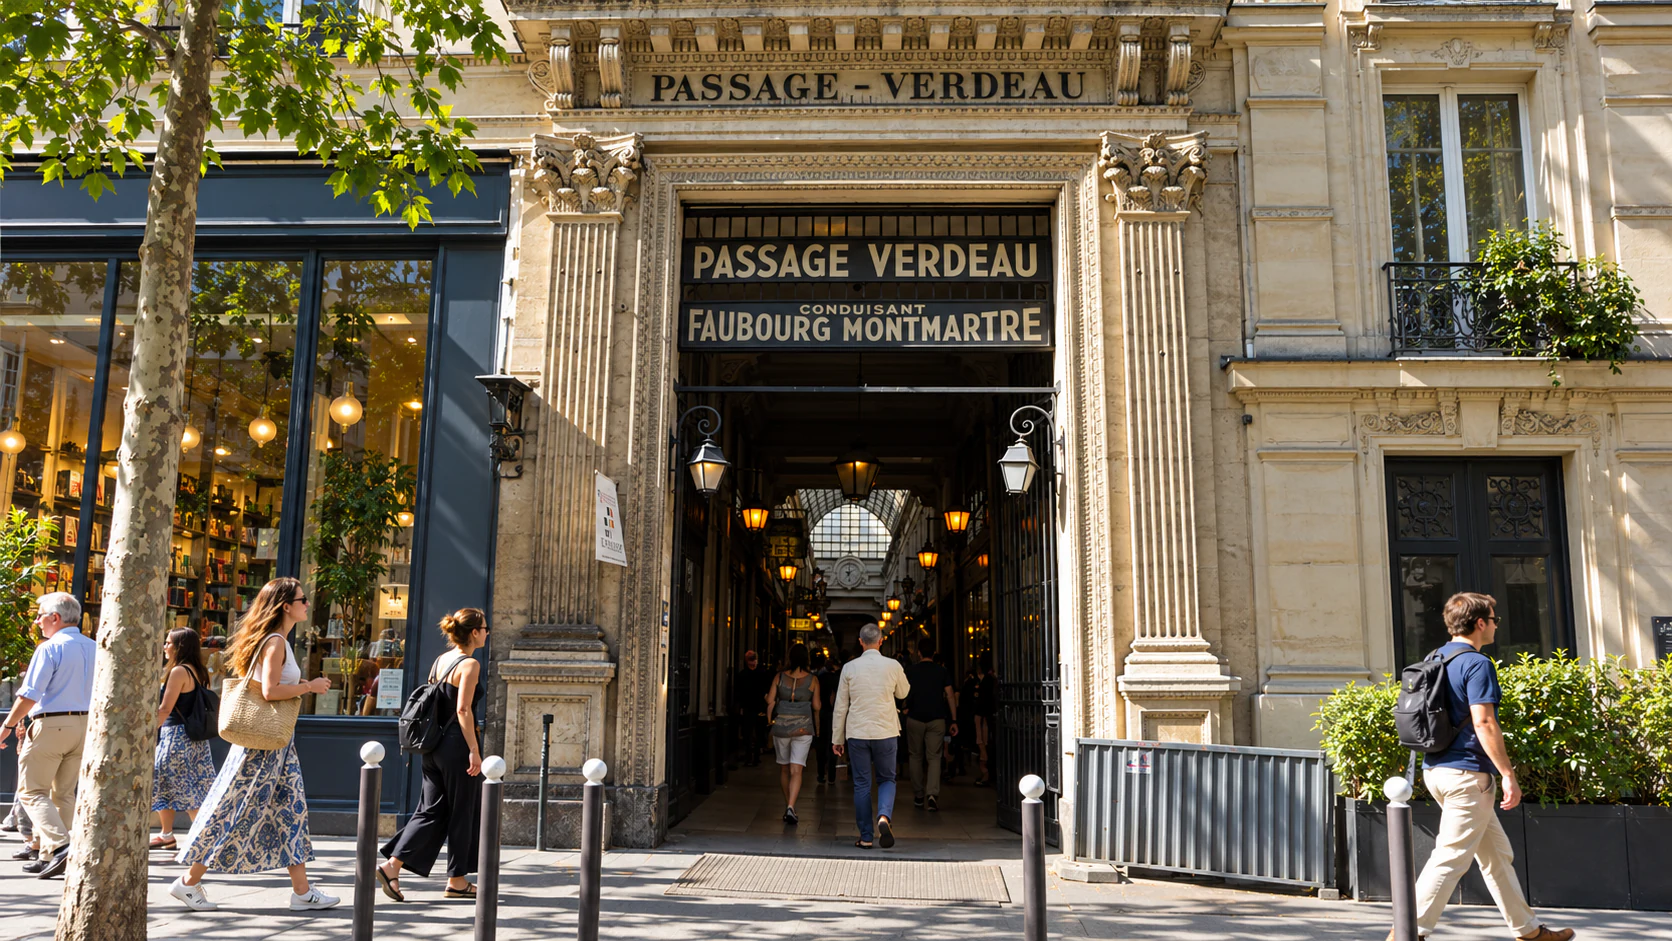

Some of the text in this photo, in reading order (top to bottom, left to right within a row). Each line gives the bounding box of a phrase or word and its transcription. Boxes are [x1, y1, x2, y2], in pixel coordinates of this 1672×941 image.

[650, 72, 839, 102] PASSAGE
[880, 71, 1087, 100] VERDEAU
[693, 243, 1038, 279] PASSAGE VERDEAU
[688, 307, 1042, 342] FAUBOURG MONTMARTRE
[799, 304, 926, 315] CONDUISANT
